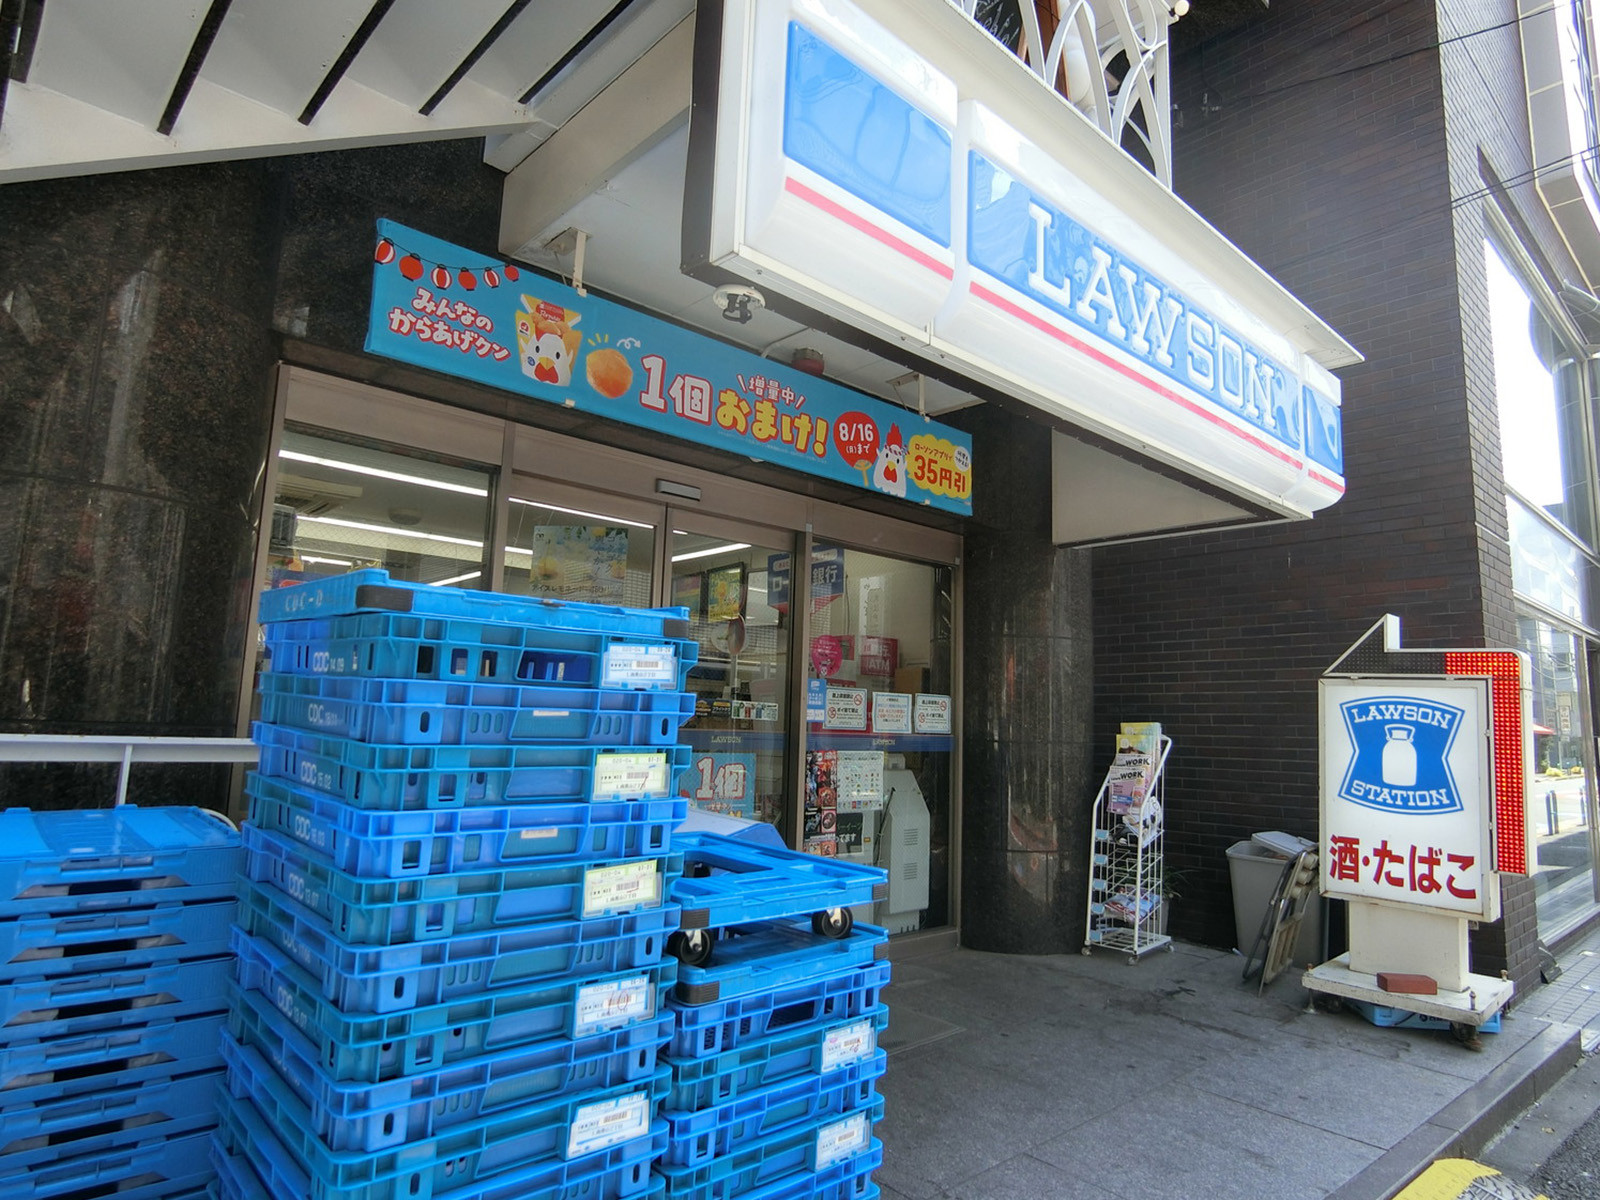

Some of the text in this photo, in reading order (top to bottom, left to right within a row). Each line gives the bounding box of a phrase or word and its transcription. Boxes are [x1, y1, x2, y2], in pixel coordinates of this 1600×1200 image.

[411, 286, 494, 333] みんなの
[1028, 203, 1277, 427] LAWSON
[388, 306, 511, 362] からあげクン
[640, 354, 713, 426] 1個
[749, 375, 796, 406] 増量中
[838, 422, 875, 443] 8/16
[913, 454, 967, 493] 35円引
[812, 565, 838, 585] 銀行
[312, 651, 329, 672] CDC
[869, 658, 890, 671] ATM
[308, 703, 325, 724] CDC
[1350, 704, 1452, 729] LAWSON
[301, 760, 317, 785] CDC
[1120, 770, 1144, 780] WORK
[1125, 758, 1150, 767] WORK
[1350, 779, 1451, 807] STATION
[294, 814, 311, 840] CDC
[1329, 834, 1477, 900] 酒・たばこ
[288, 872, 304, 900] CDC
